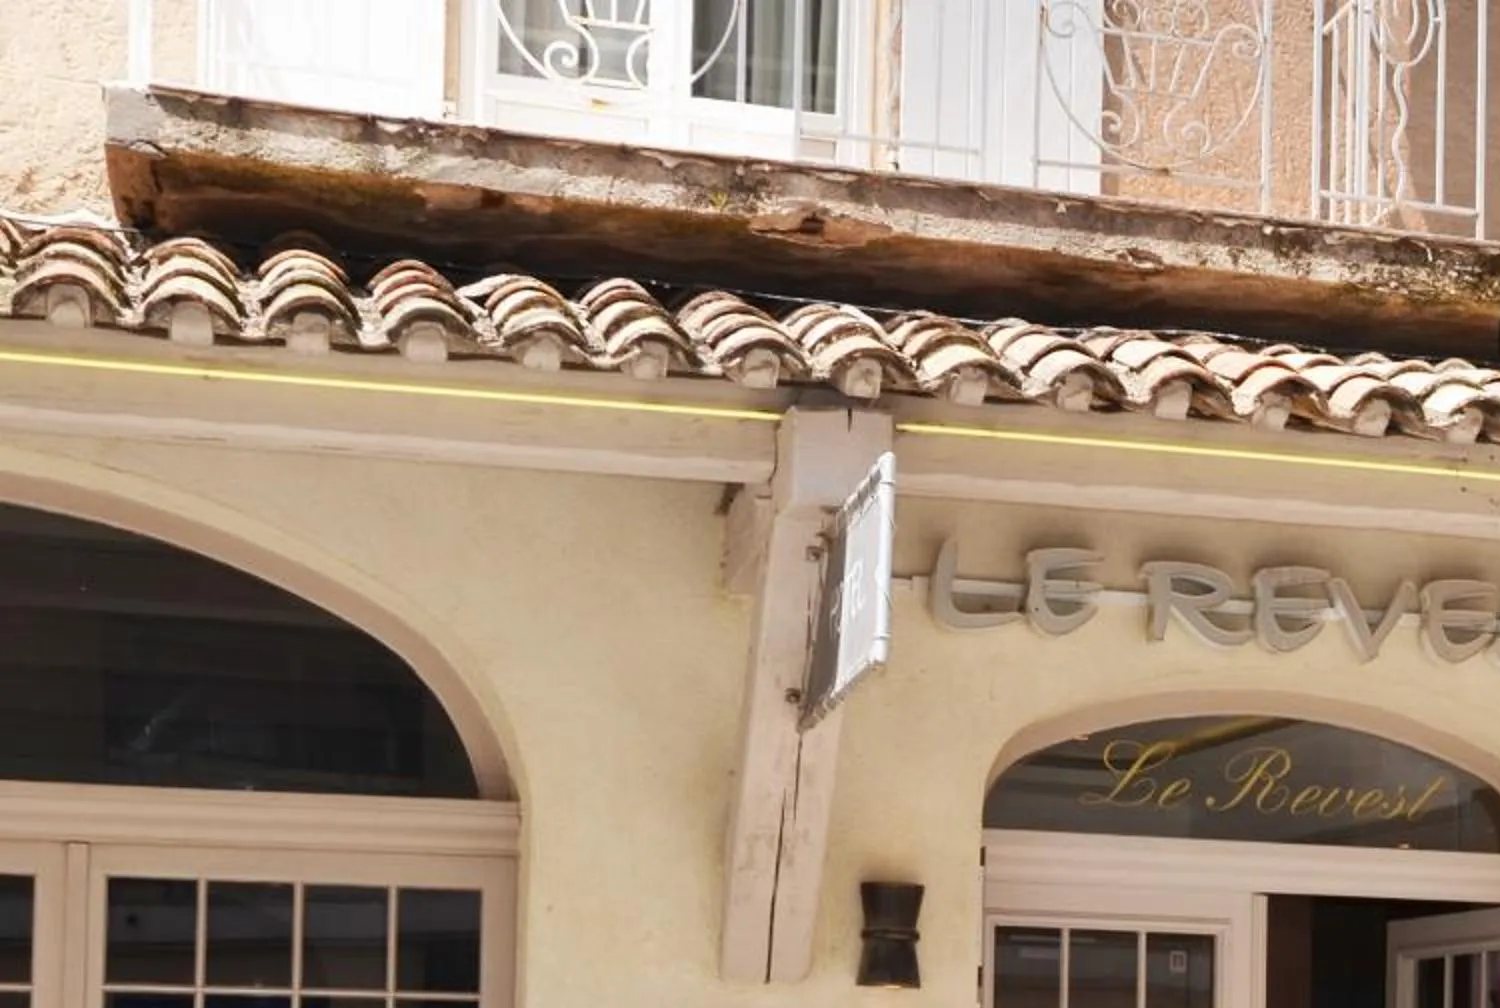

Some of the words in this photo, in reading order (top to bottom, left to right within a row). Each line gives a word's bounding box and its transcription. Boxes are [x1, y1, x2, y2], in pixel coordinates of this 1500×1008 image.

[934, 537, 1104, 636] LE
[1080, 739, 1192, 810] Le
[1204, 747, 1445, 822] Revest
